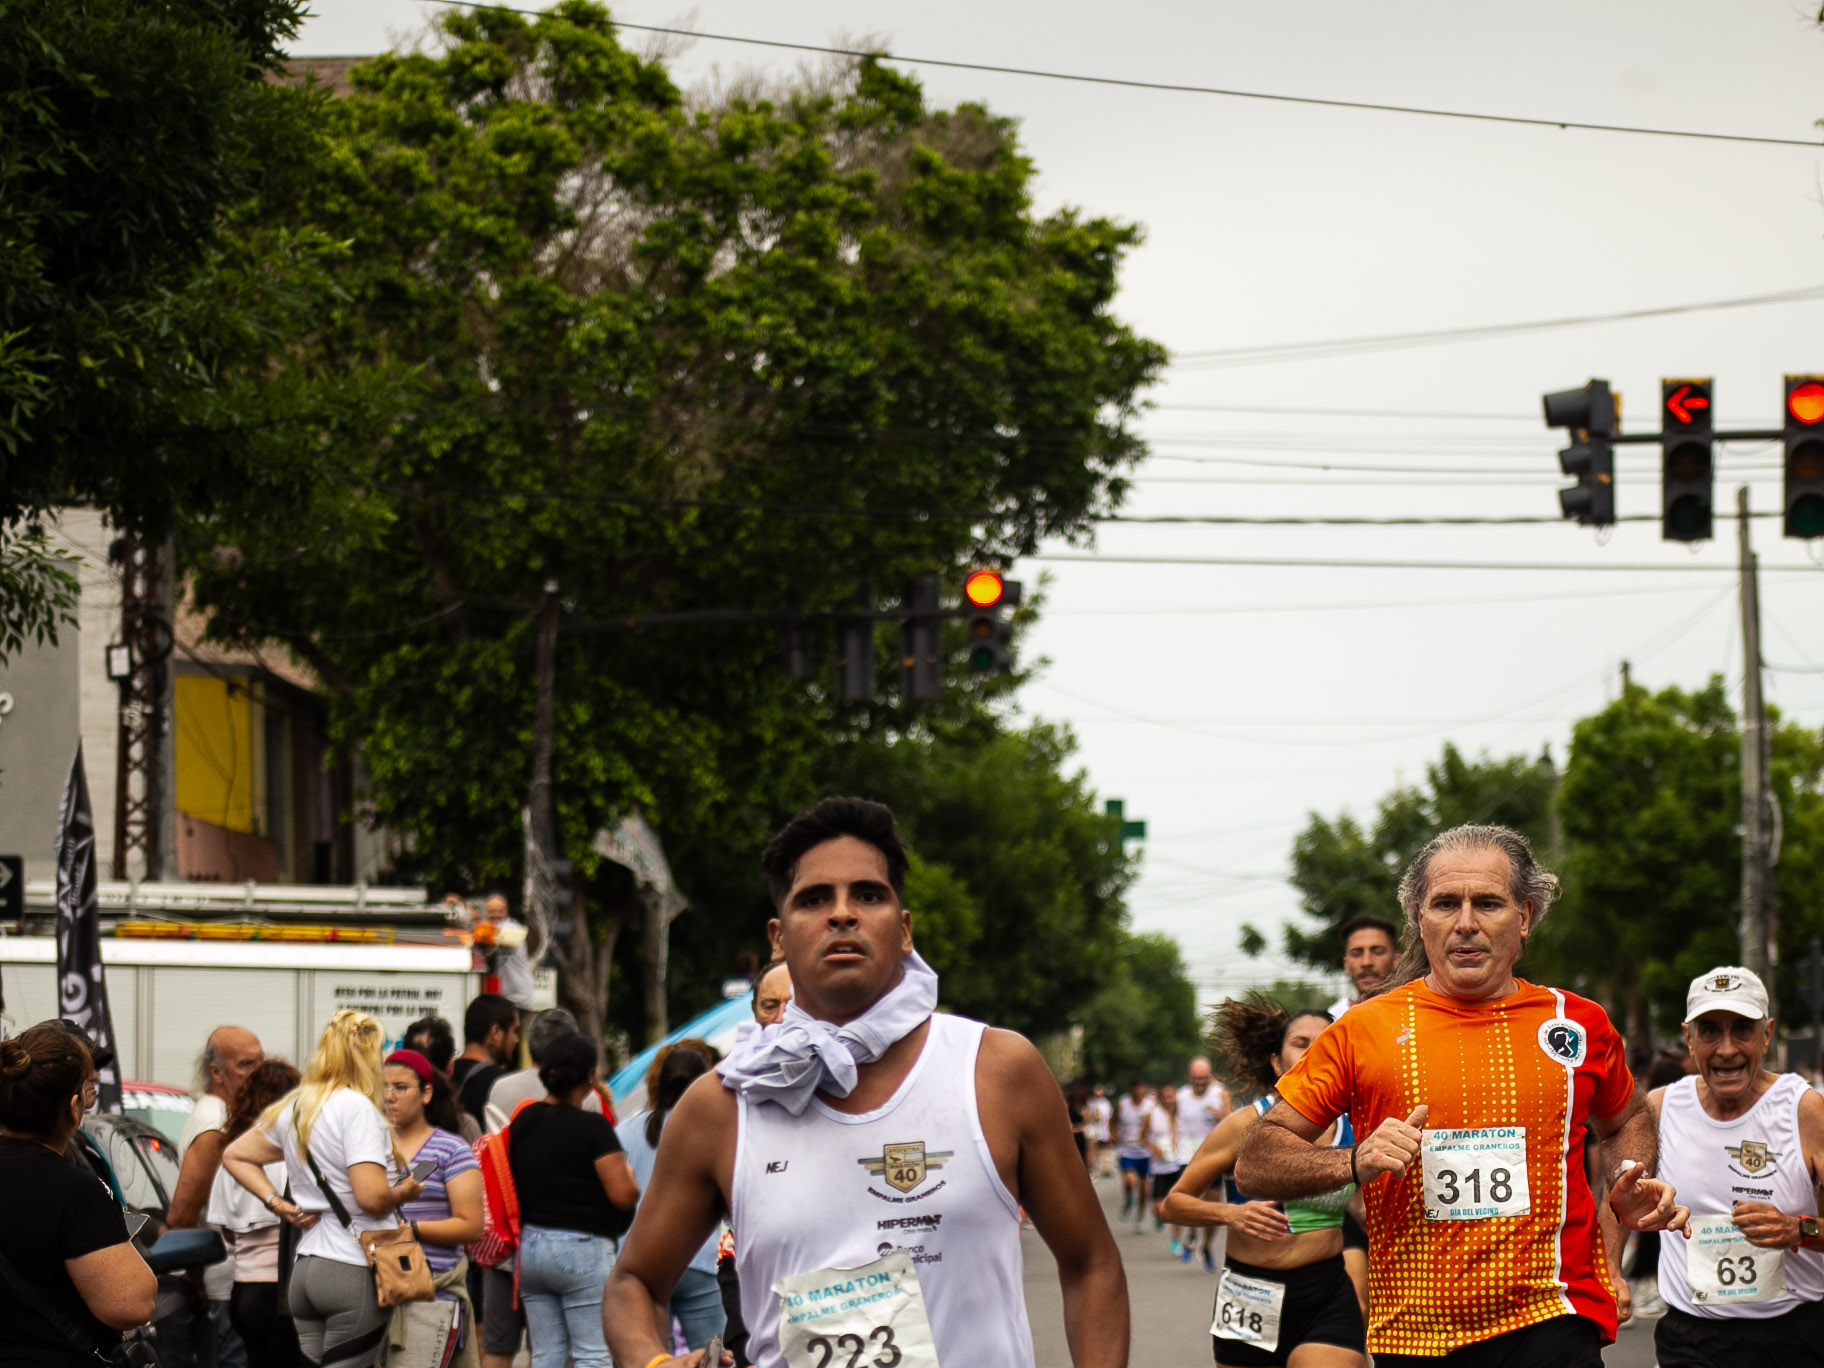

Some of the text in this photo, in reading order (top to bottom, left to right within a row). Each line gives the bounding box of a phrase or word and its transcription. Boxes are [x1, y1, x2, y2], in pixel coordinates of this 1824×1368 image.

[1434, 1129, 1516, 1140] 40 MARATON
[1430, 1143, 1520, 1152] EMPALME GRANEROS
[766, 1160, 789, 1175] NEJ
[1745, 1158, 1761, 1167] 40
[894, 1168, 918, 1183] 40
[1436, 1167, 1512, 1205] 318
[867, 1186, 904, 1203] EMPALME
[1450, 1208, 1462, 1216] DIA
[1475, 1207, 1499, 1216] VECINO
[1717, 1255, 1757, 1286] 63
[786, 1272, 891, 1308] 40 MARATON
[840, 1288, 900, 1311] GRANEROS
[1222, 1302, 1262, 1333] 618
